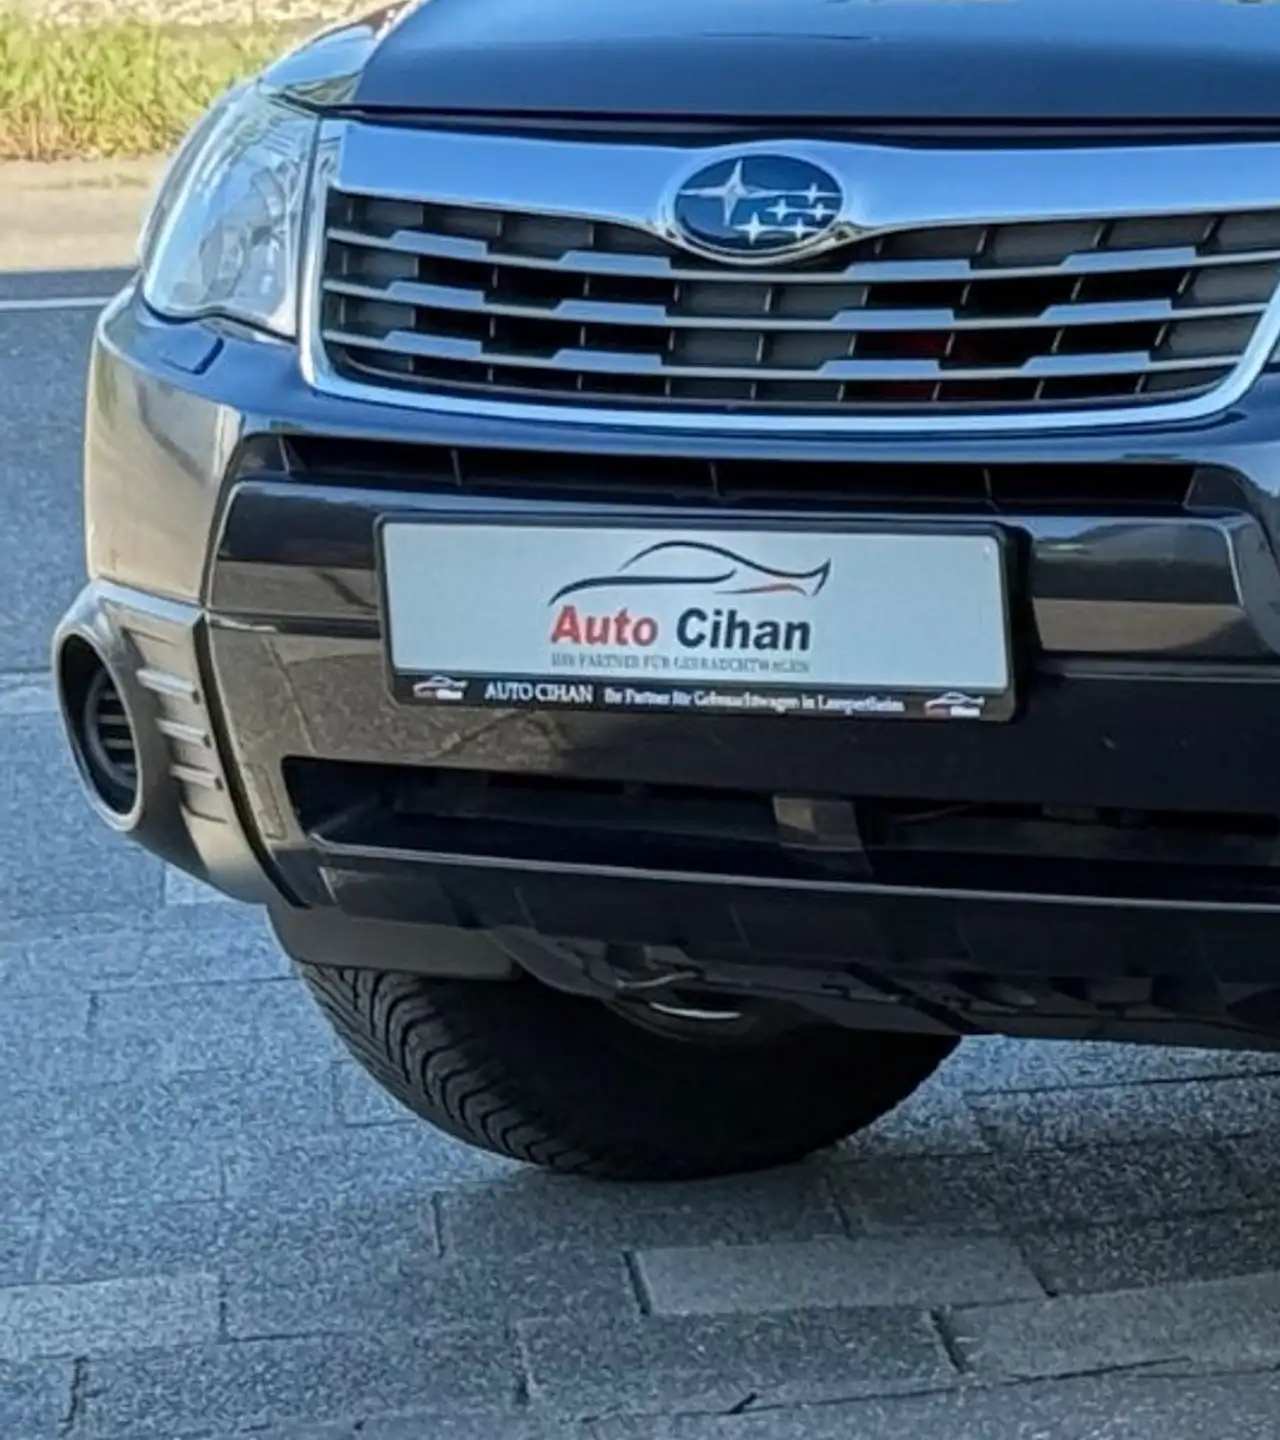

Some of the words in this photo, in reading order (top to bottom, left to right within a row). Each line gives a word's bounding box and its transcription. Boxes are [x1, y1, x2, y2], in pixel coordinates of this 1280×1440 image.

[549, 605, 658, 648] Auto
[676, 607, 812, 652] Cihan
[484, 680, 534, 701] AUTO
[535, 683, 593, 703] CIHAN
